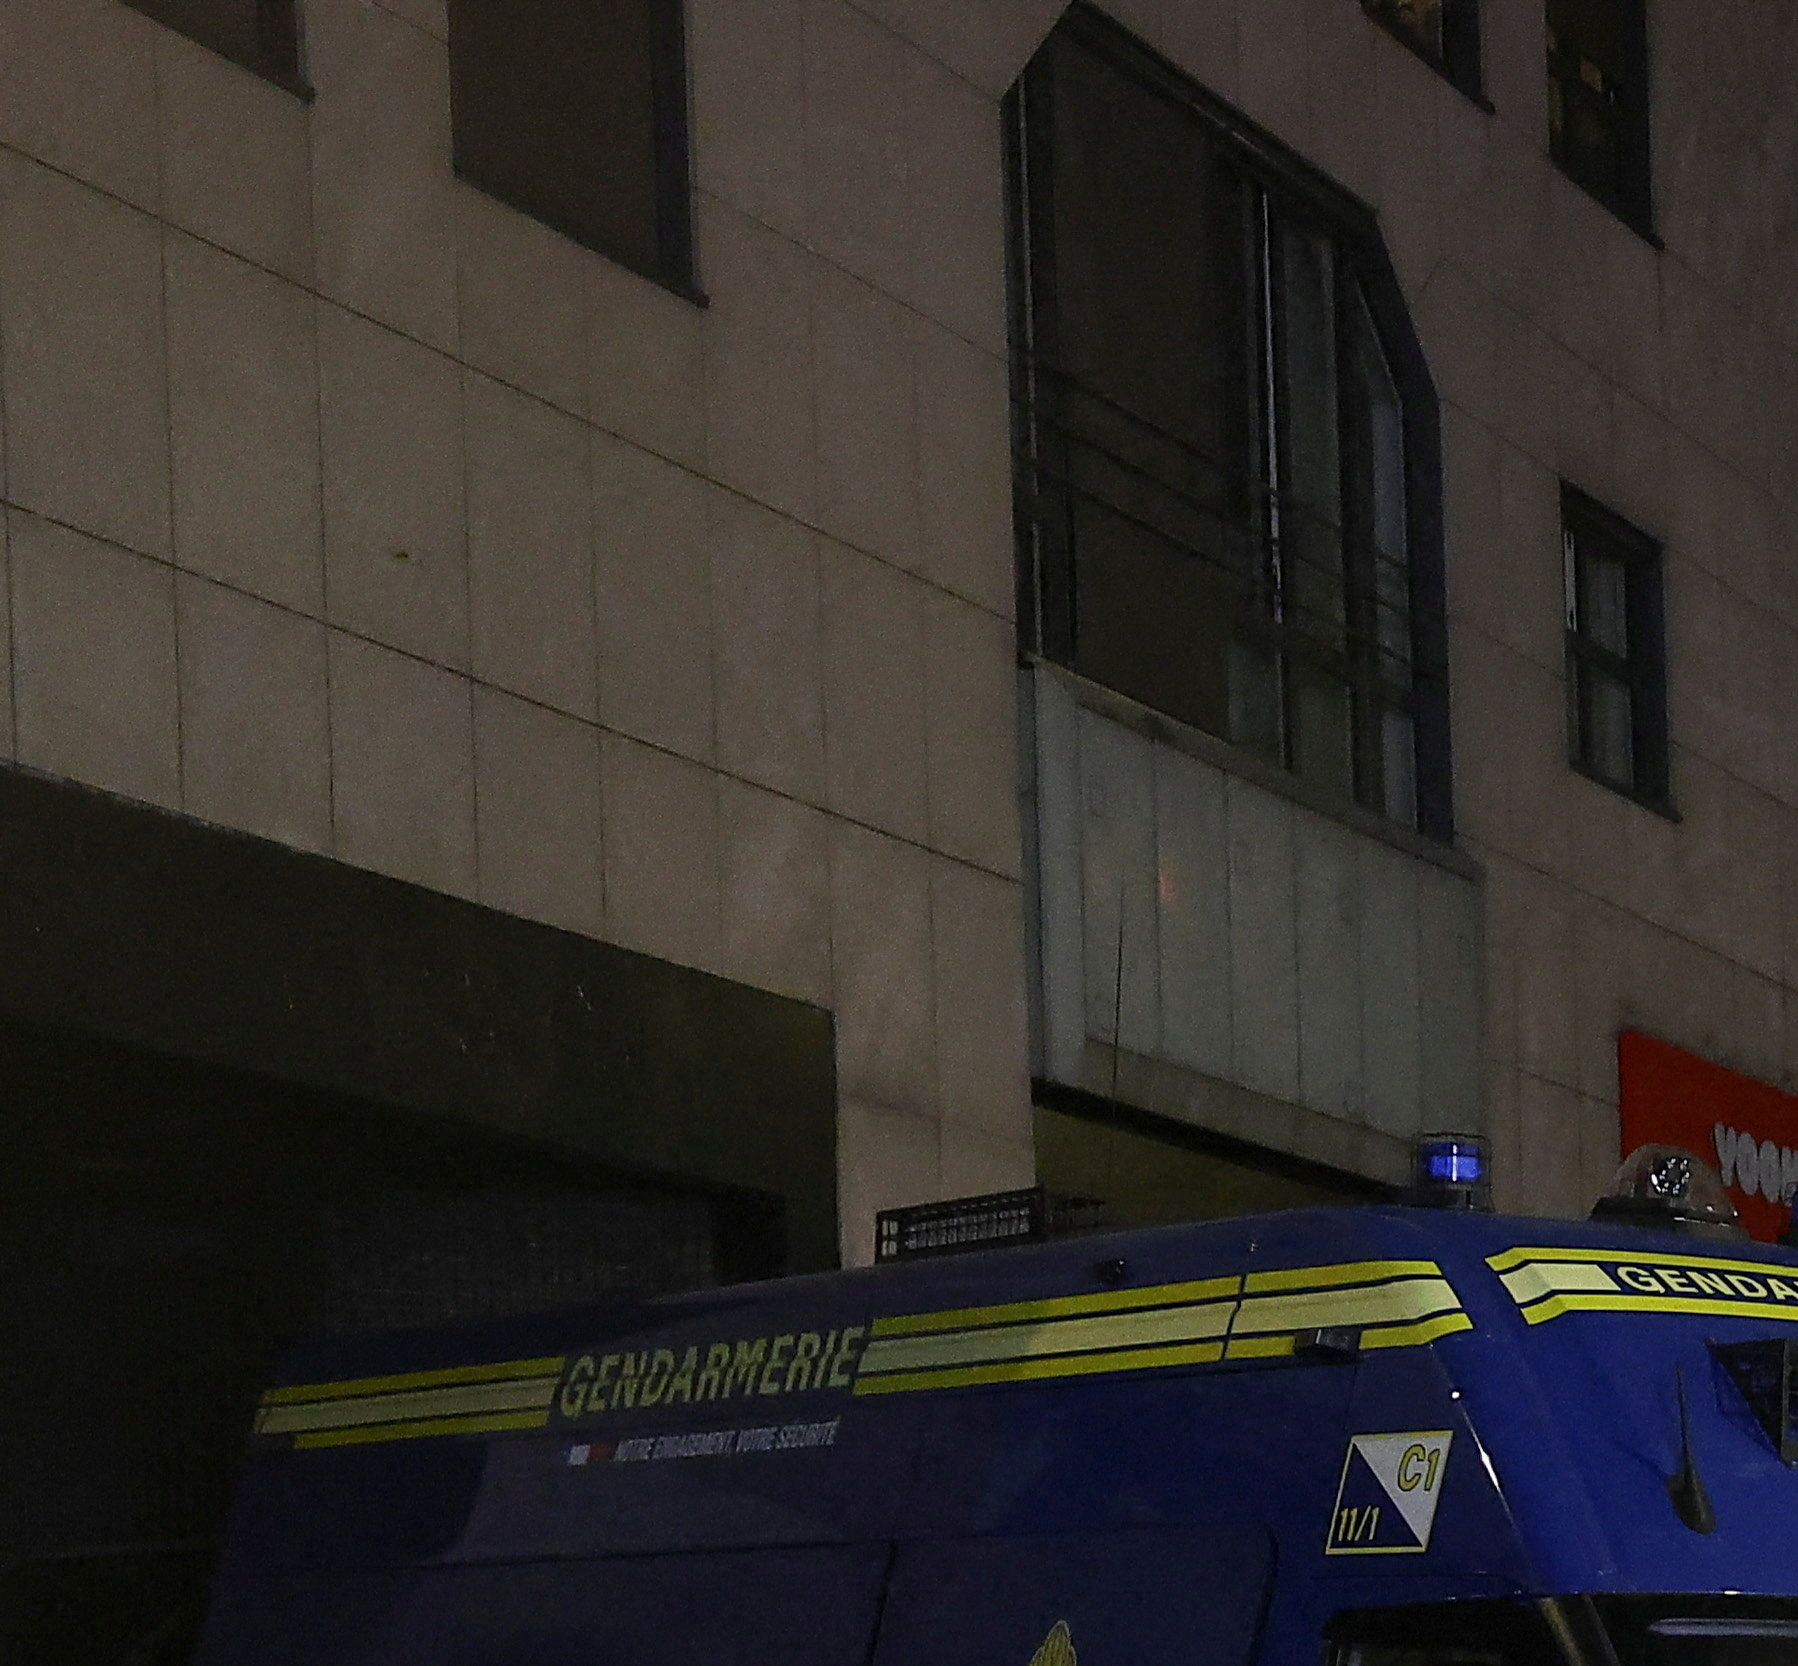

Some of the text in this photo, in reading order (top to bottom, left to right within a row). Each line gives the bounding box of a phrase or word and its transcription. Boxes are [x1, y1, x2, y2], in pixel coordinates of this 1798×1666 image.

[560, 1326, 866, 1419] GENDARMERIE
[1397, 1443, 1440, 1492] C1
[1337, 1504, 1381, 1542] 11/1
